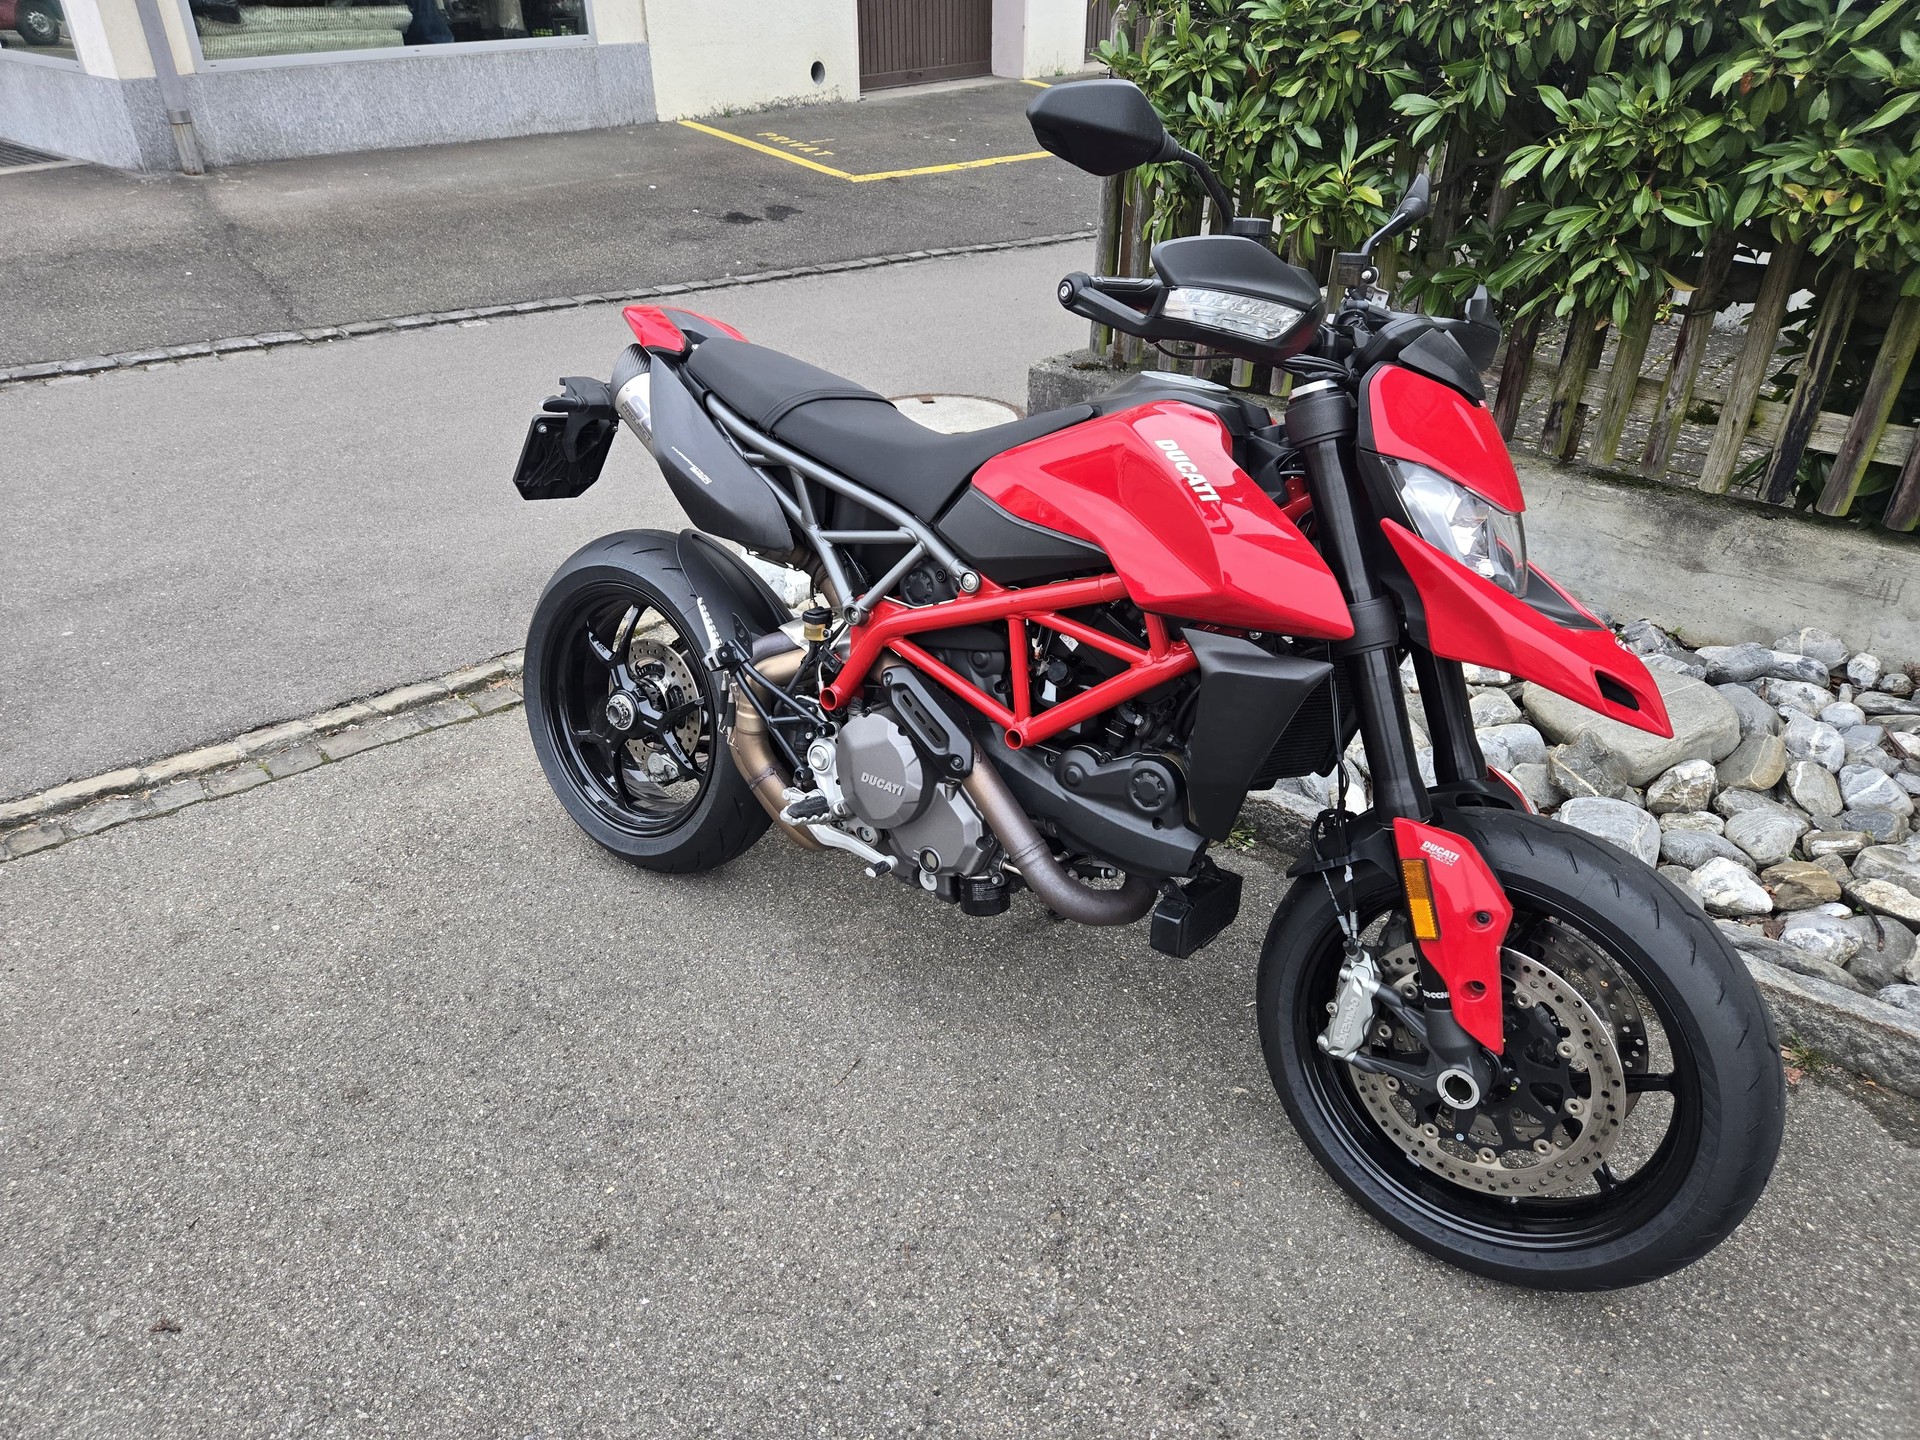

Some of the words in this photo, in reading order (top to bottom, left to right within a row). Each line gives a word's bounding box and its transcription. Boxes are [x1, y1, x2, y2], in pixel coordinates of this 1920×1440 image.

[756, 131, 835, 156] PRIVAT
[621, 403, 653, 442] PROJECT
[1154, 439, 1222, 503] DUCATI
[860, 771, 904, 796] DUCATI
[1422, 841, 1459, 860] DUCATI
[1335, 996, 1360, 1045] brembo
